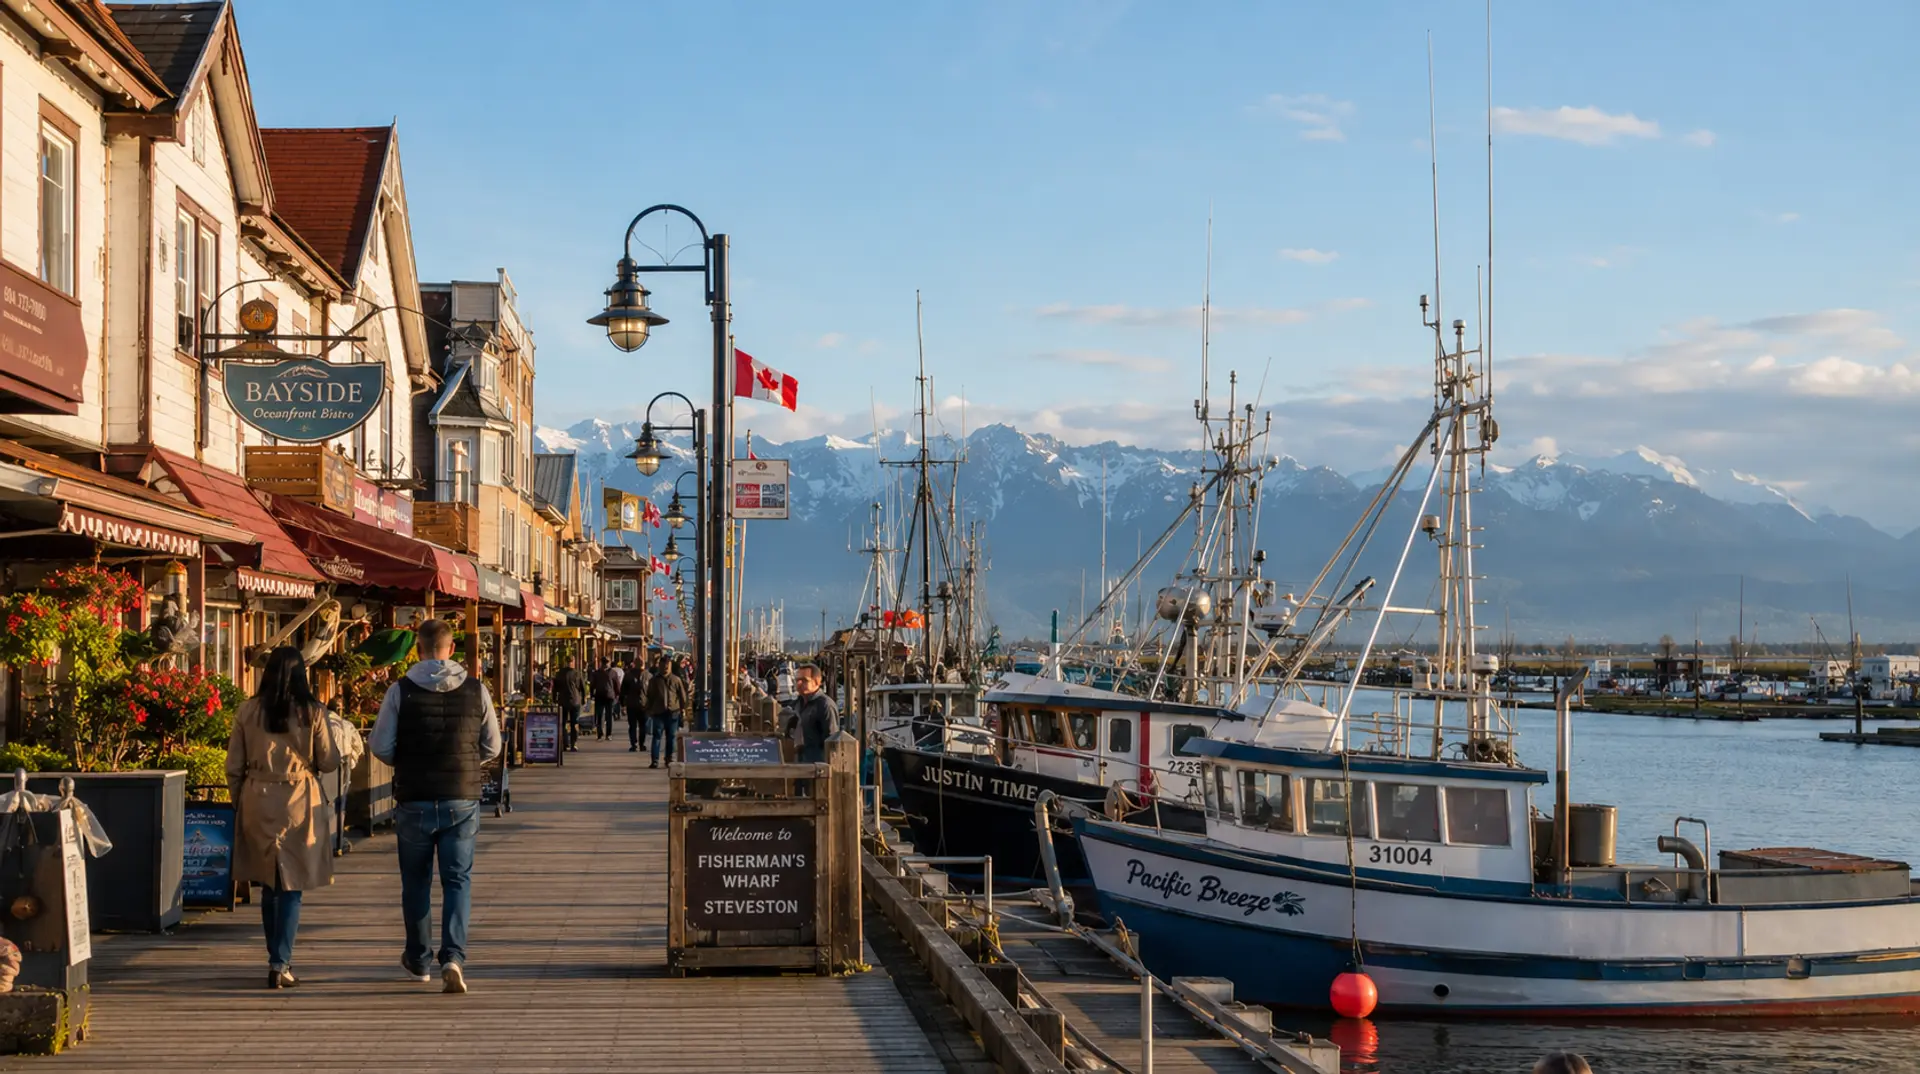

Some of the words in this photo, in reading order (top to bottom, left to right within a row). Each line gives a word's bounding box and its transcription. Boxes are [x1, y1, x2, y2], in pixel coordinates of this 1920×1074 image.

[246, 381, 363, 403] BAYSIDE
[253, 406, 316, 423] Oceanfront
[320, 407, 354, 420] Bistro
[990, 778, 1039, 802] TIME
[709, 826, 773, 841] Welcome
[778, 827, 792, 841] to
[698, 854, 806, 868] FISHERMAN'S
[1369, 845, 1433, 866] 31004
[722, 874, 780, 889] WHARF
[1127, 858, 1192, 899] Pacific
[1197, 874, 1271, 917] Breeze
[704, 899, 799, 915] STEVESTON
